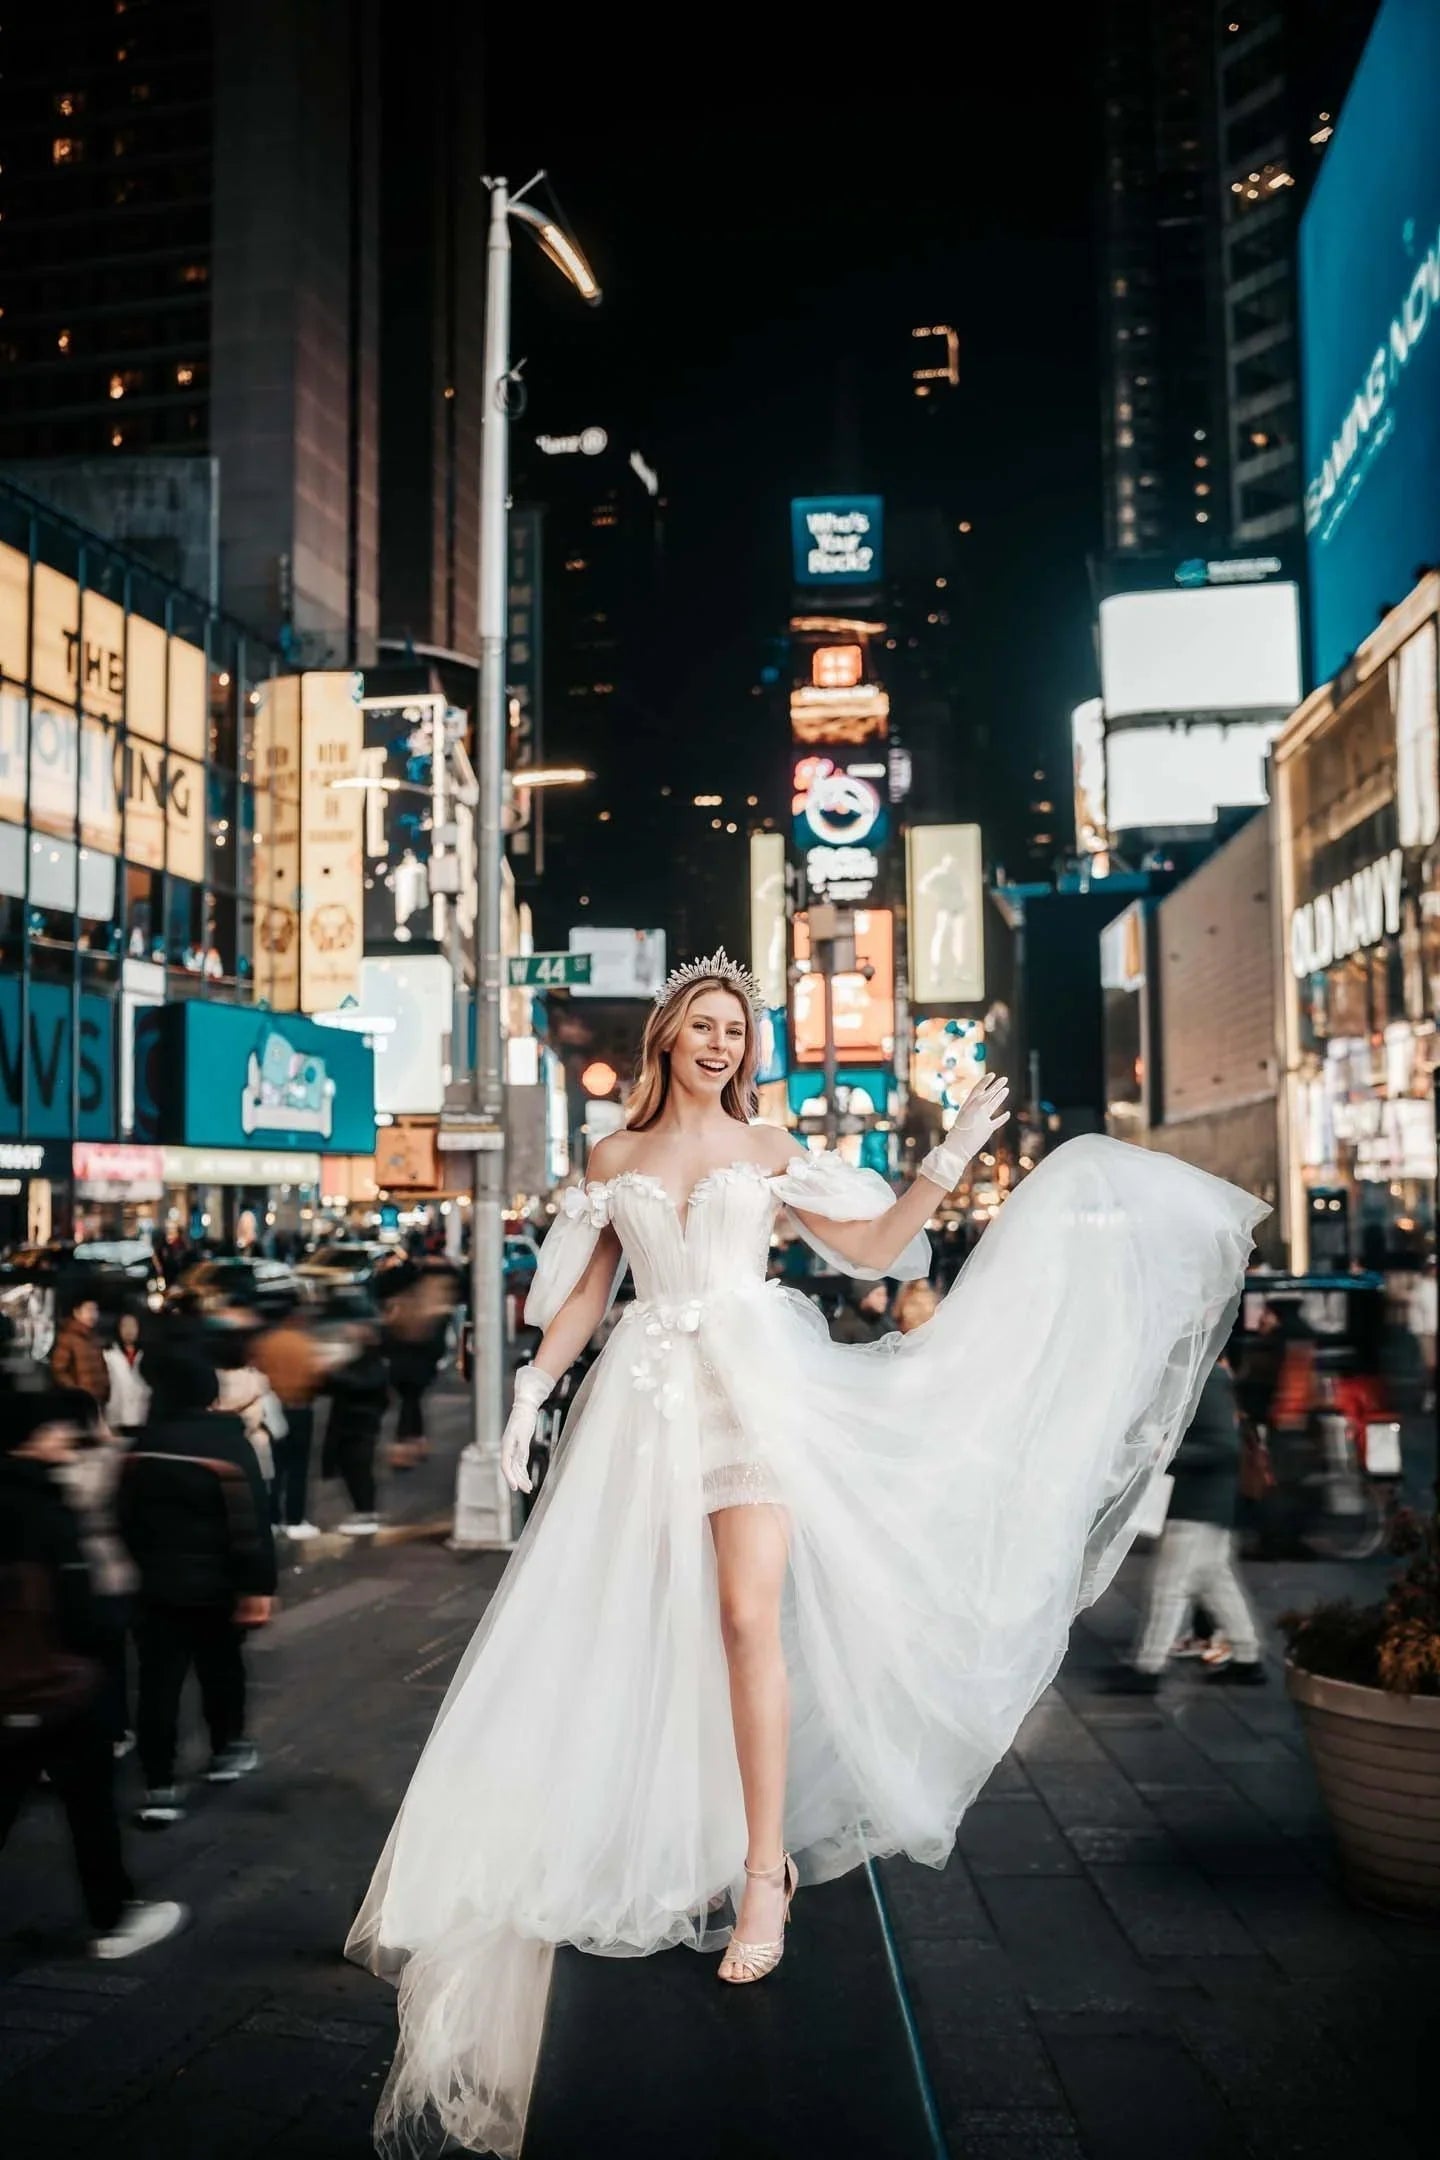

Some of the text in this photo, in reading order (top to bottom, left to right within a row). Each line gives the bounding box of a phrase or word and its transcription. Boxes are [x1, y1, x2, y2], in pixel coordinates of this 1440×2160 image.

[62, 628, 123, 694] THE
[511, 959, 529, 984] W
[535, 957, 566, 984] 44
